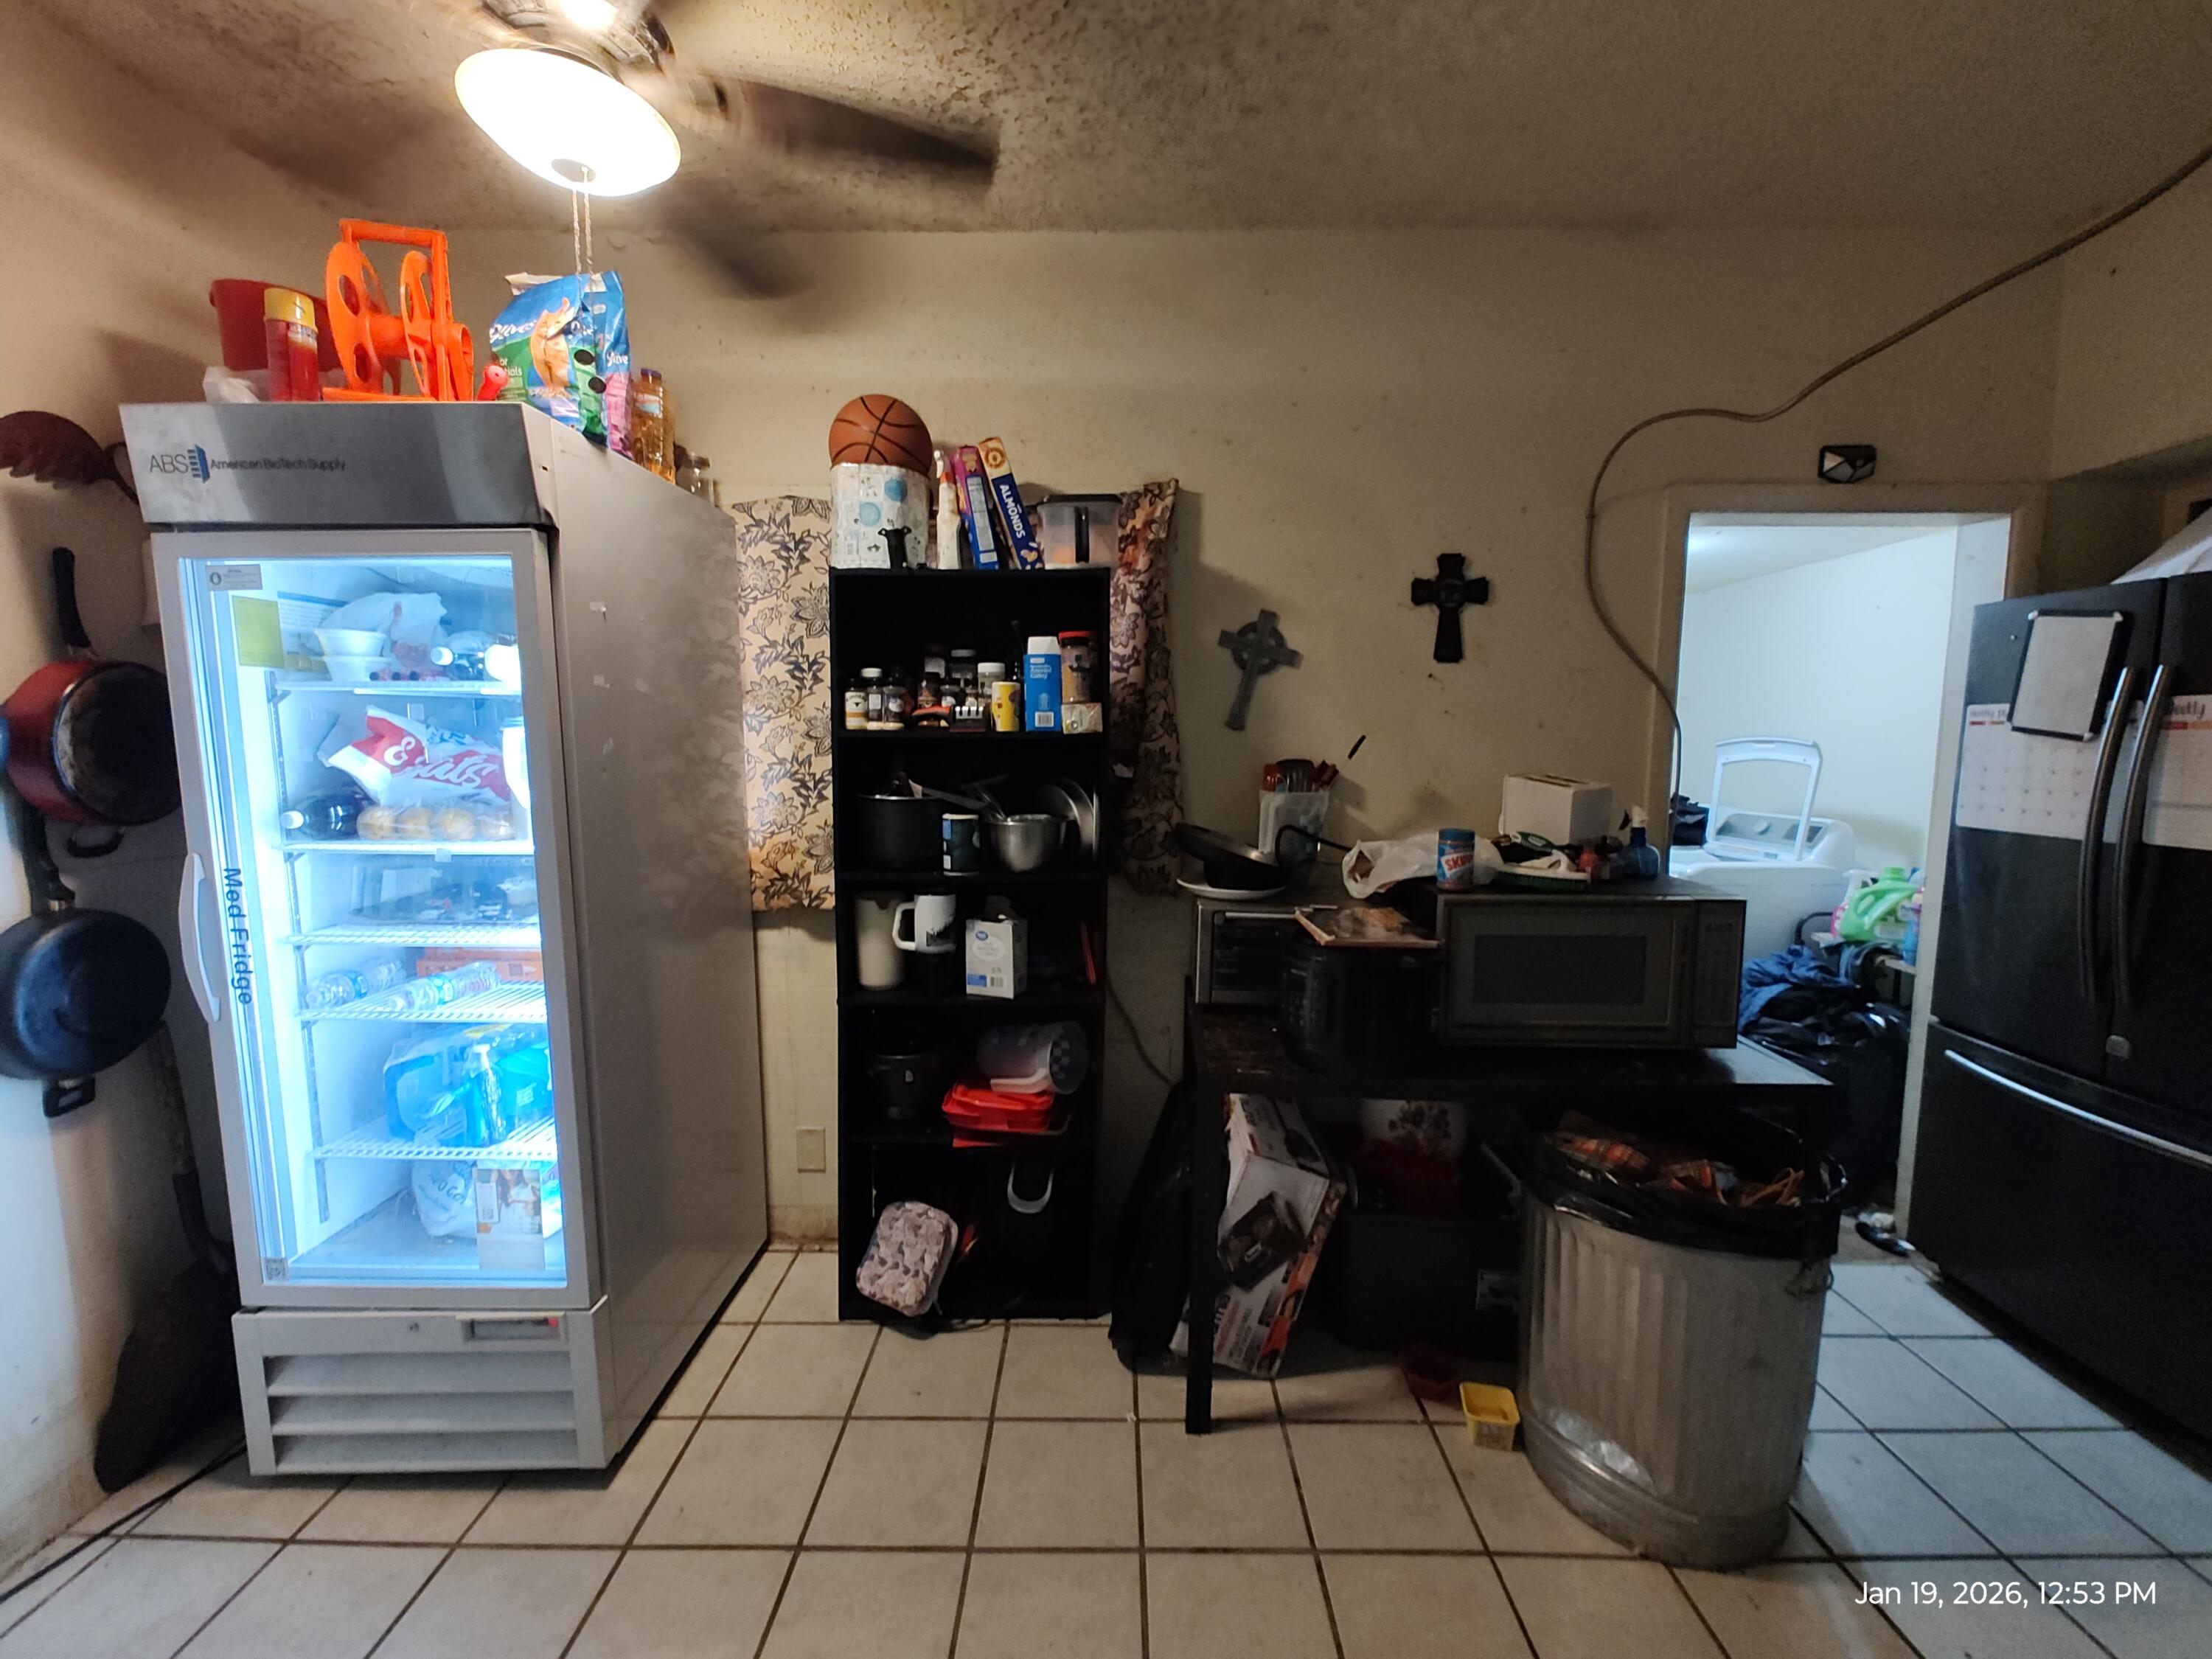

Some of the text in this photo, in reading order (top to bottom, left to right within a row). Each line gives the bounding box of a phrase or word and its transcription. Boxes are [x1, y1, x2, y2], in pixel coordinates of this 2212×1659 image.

[150, 453, 189, 473] ABS
[210, 458, 345, 472] American BioTech Supply
[999, 484, 1026, 539] ALMONDS
[223, 867, 254, 1006] Med Fridge
